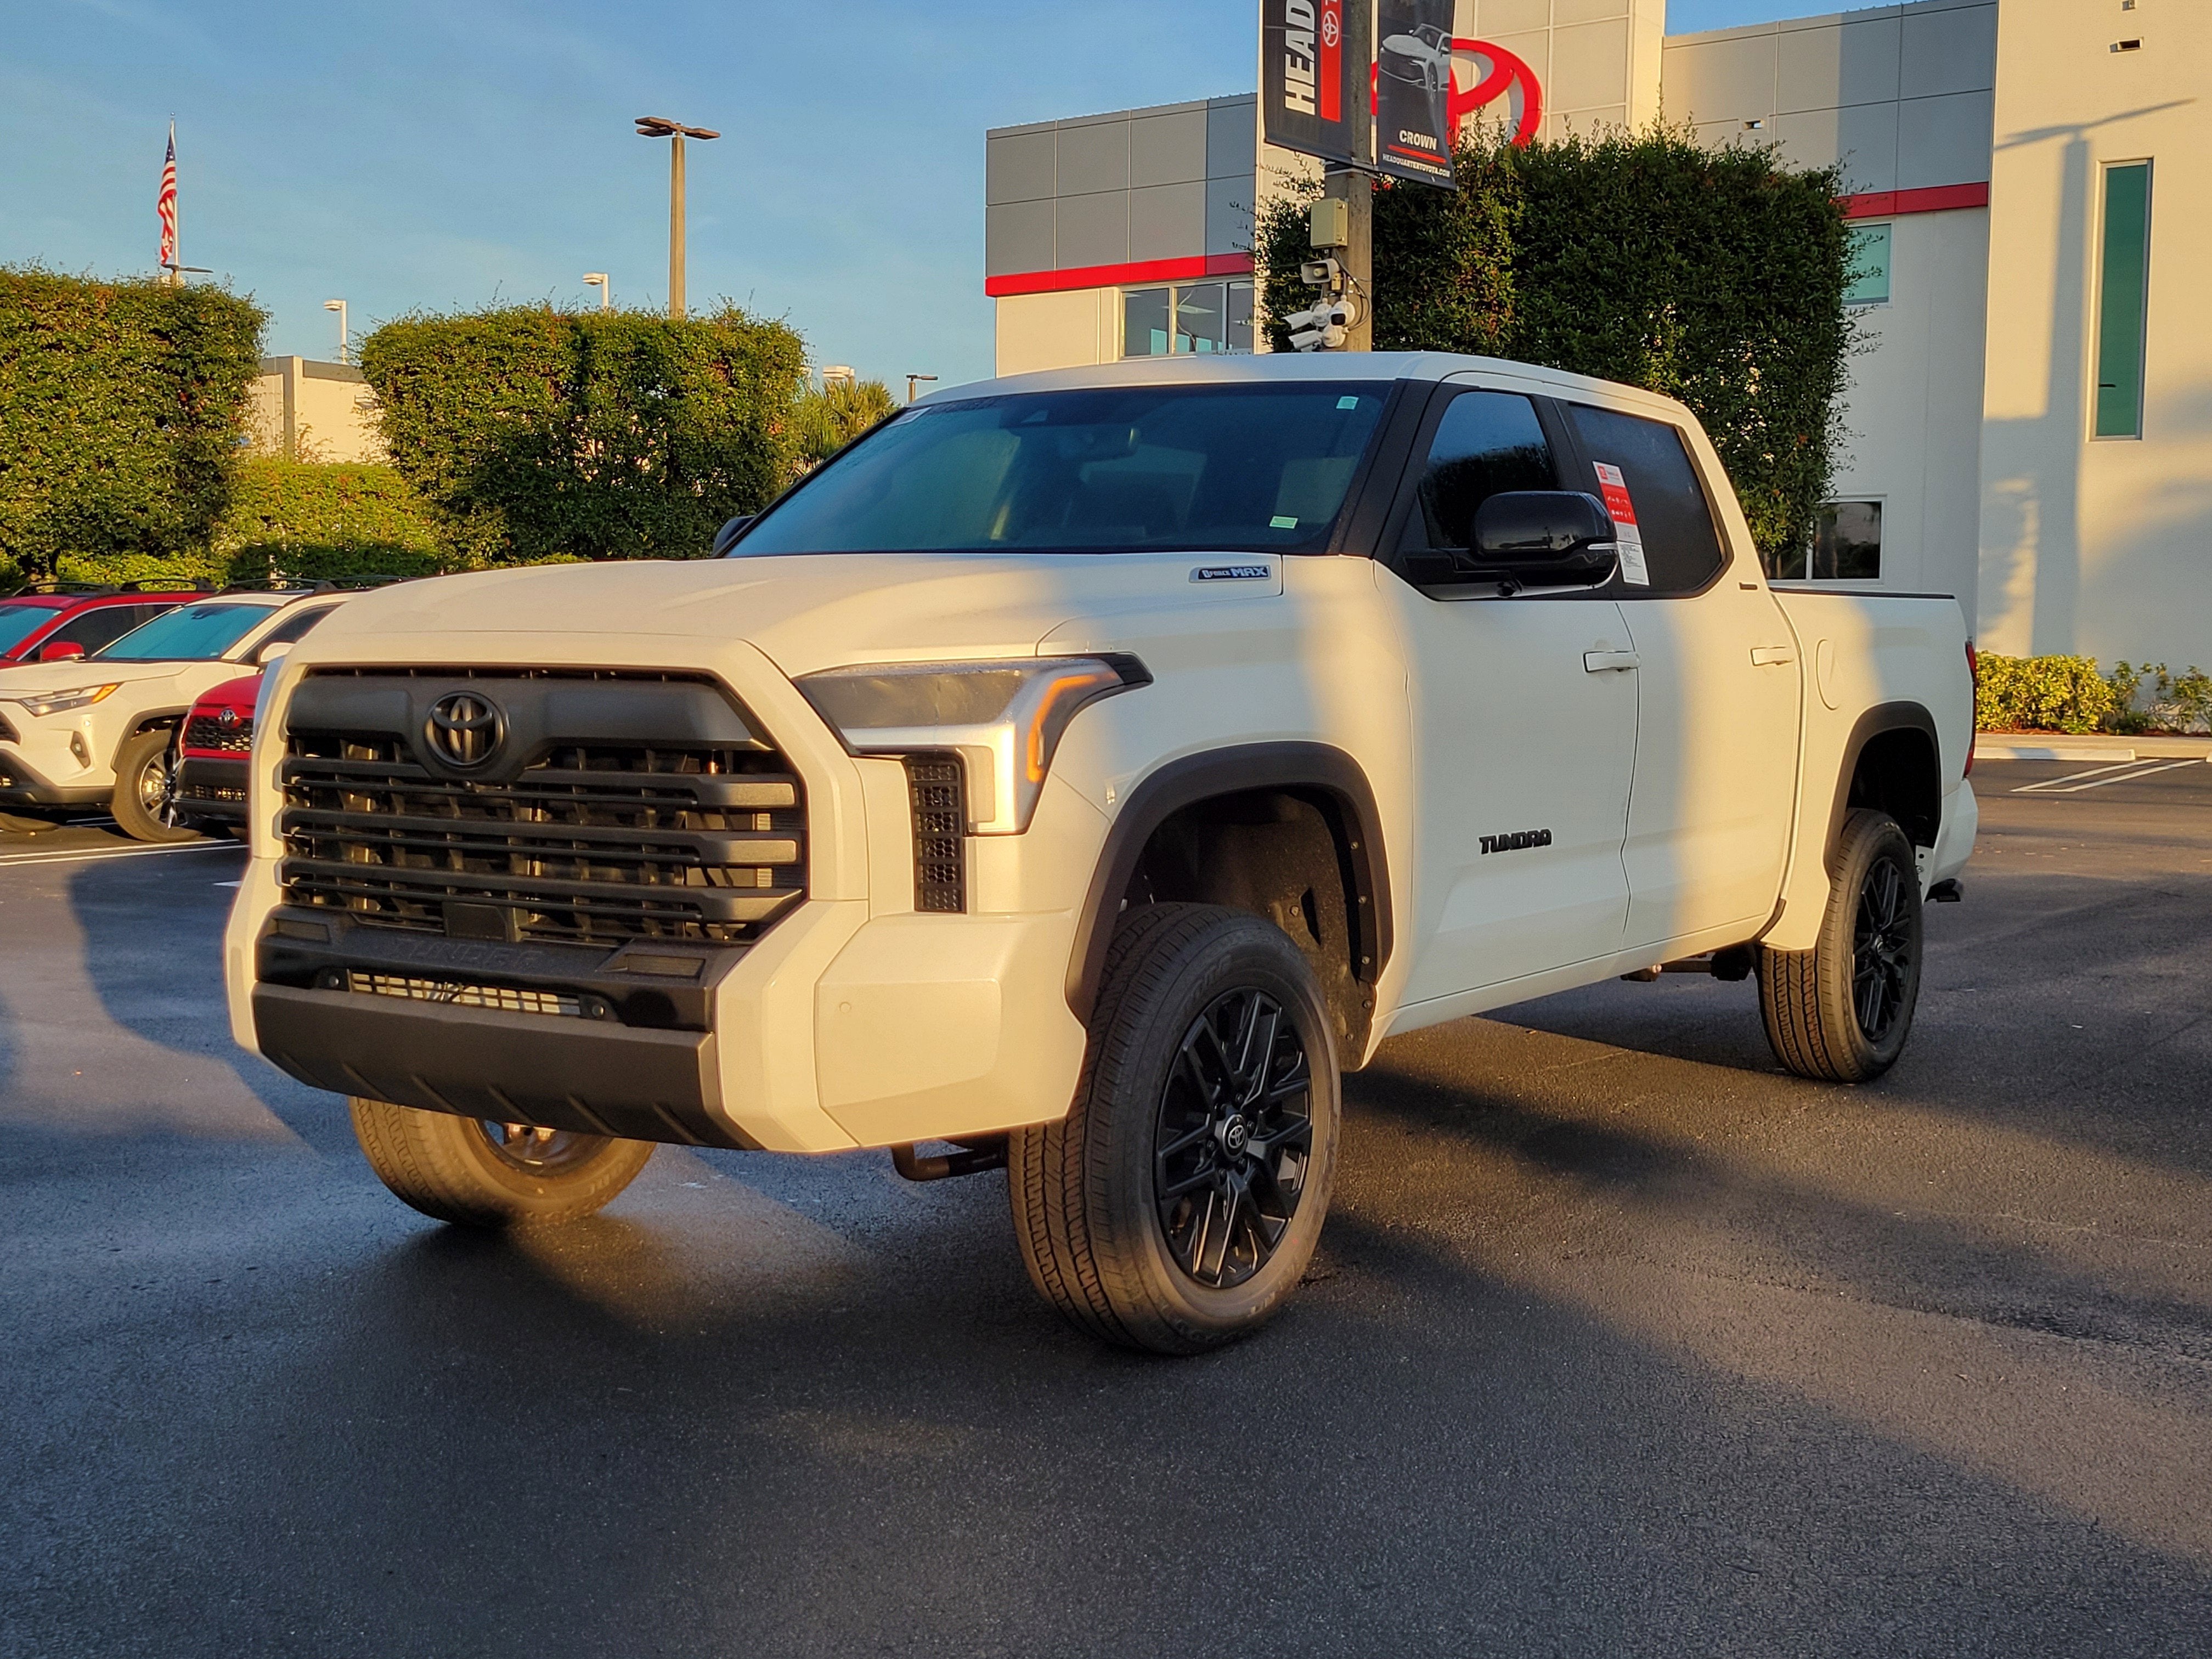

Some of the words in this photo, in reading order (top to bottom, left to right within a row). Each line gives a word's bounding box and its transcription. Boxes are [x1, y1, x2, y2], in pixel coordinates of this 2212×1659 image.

[1285, 0, 1316, 115] HEAD
[1399, 129, 1437, 150] CROWN
[1230, 567, 1268, 577] MAX
[1479, 828, 1552, 855] TUNDRA
